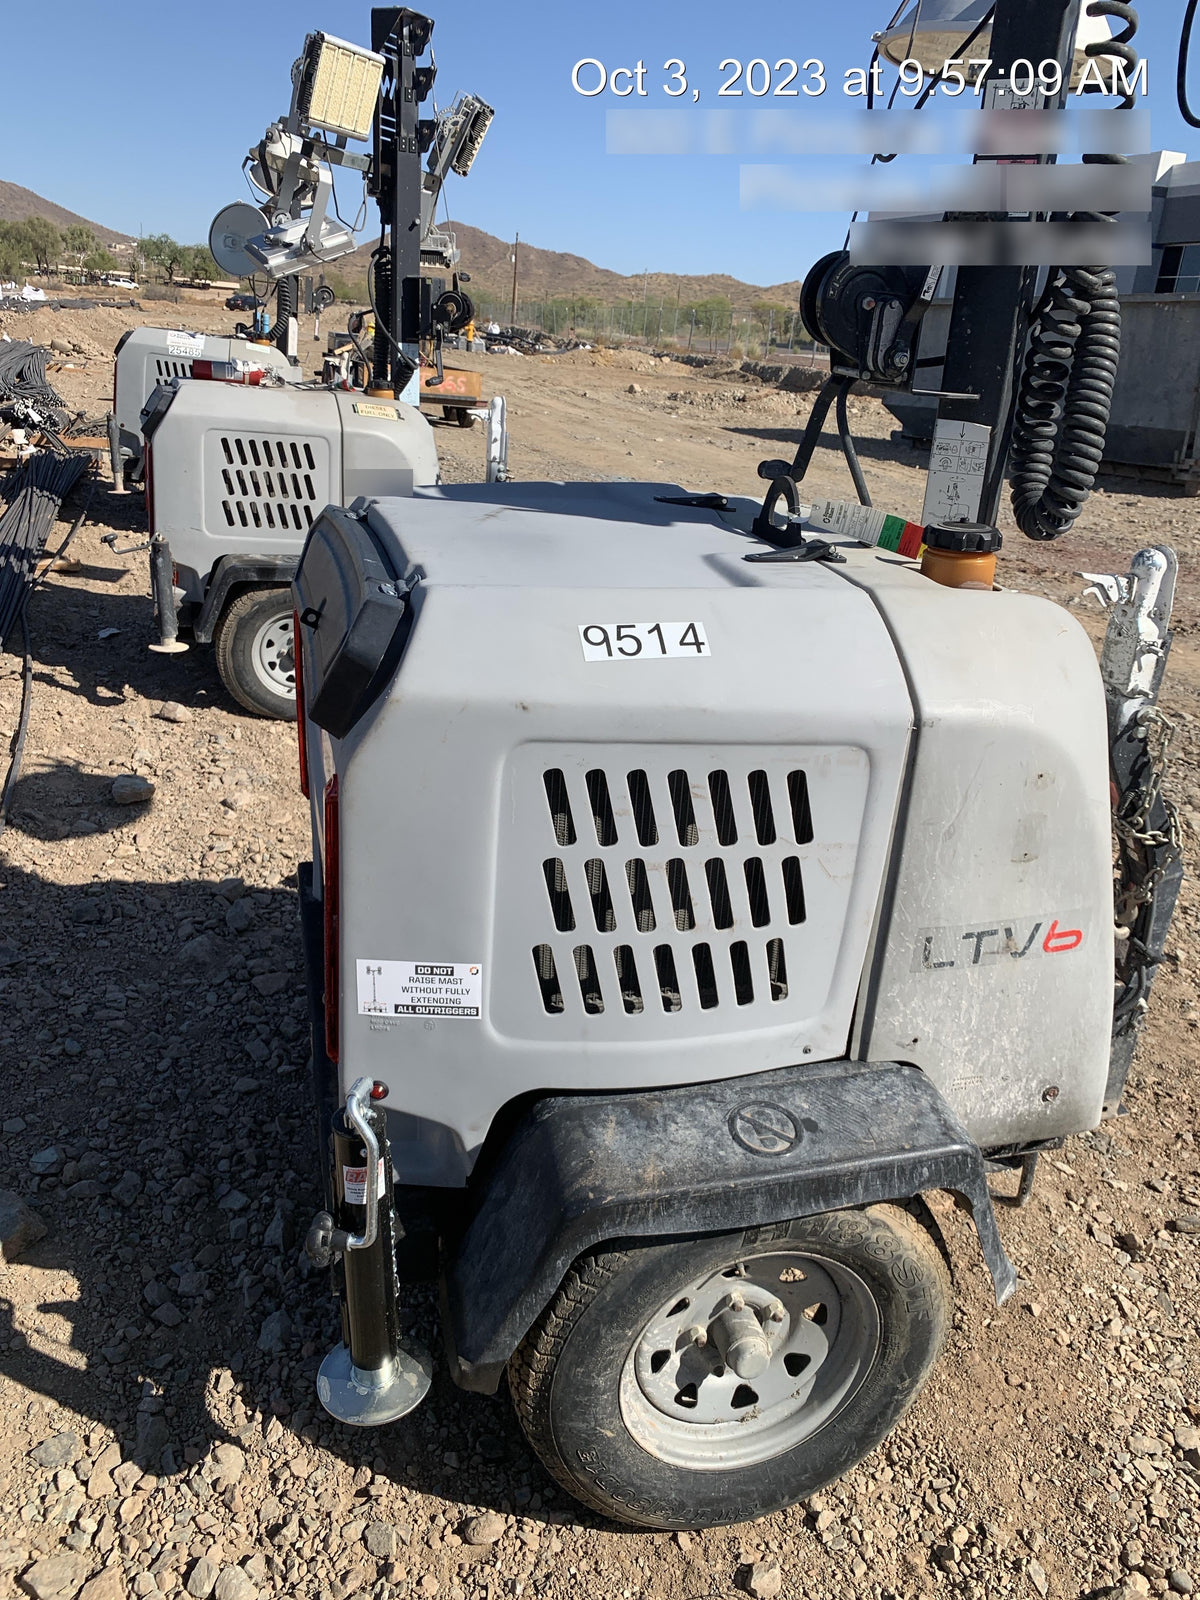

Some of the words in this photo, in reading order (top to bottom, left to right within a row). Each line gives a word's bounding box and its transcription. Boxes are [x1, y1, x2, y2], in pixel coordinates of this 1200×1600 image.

[582, 622, 706, 657] 9514
[417, 966, 432, 975] DO
[433, 967, 453, 975] NOT
[408, 976, 436, 985] RAISE
[438, 977, 464, 985] MAST
[401, 986, 444, 995] WITHOUT
[445, 987, 471, 996] FULLY
[411, 996, 462, 1005] EXTENDING
[397, 1005, 414, 1014] ALL
[415, 1006, 477, 1015] OUTRIGGERS
